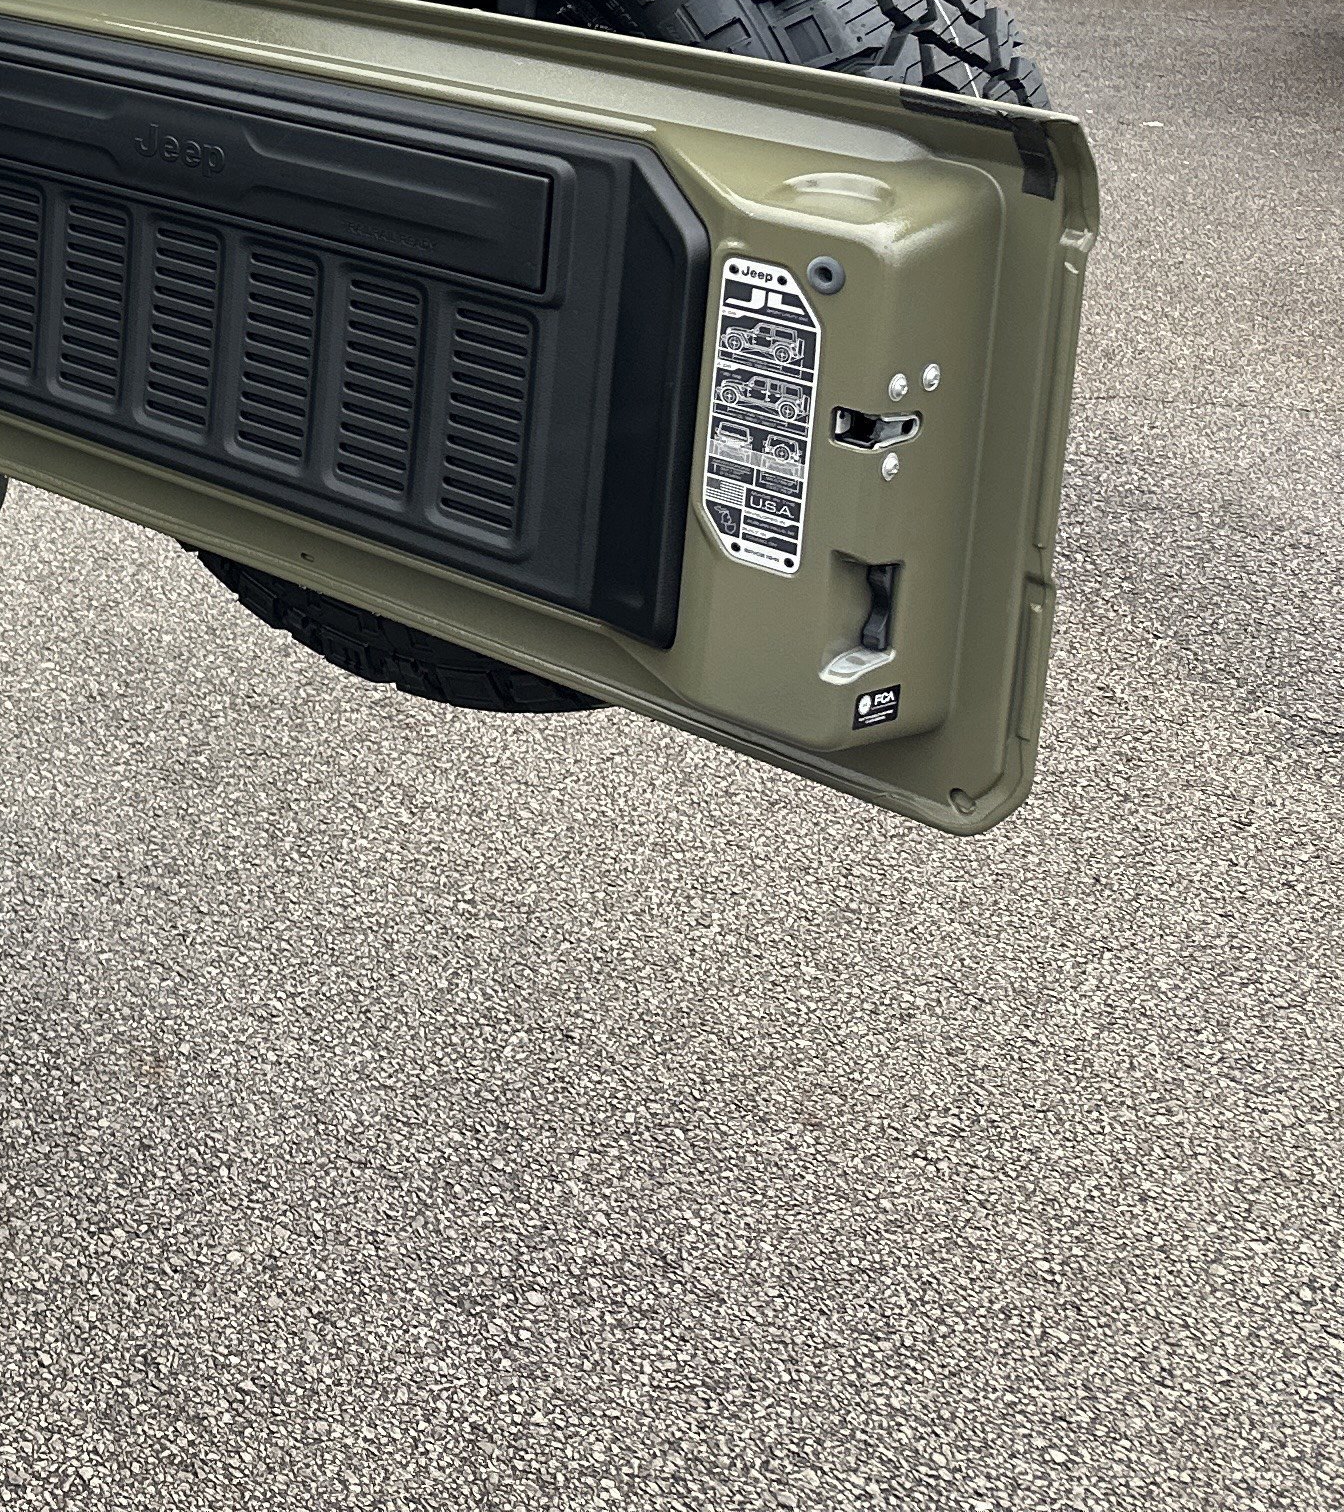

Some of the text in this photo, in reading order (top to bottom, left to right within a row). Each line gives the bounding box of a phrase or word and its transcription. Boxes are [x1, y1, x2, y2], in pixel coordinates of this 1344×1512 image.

[134, 123, 227, 178] Jeep
[741, 266, 773, 283] Jeep
[724, 287, 806, 316] JL
[874, 691, 895, 706] FCA
